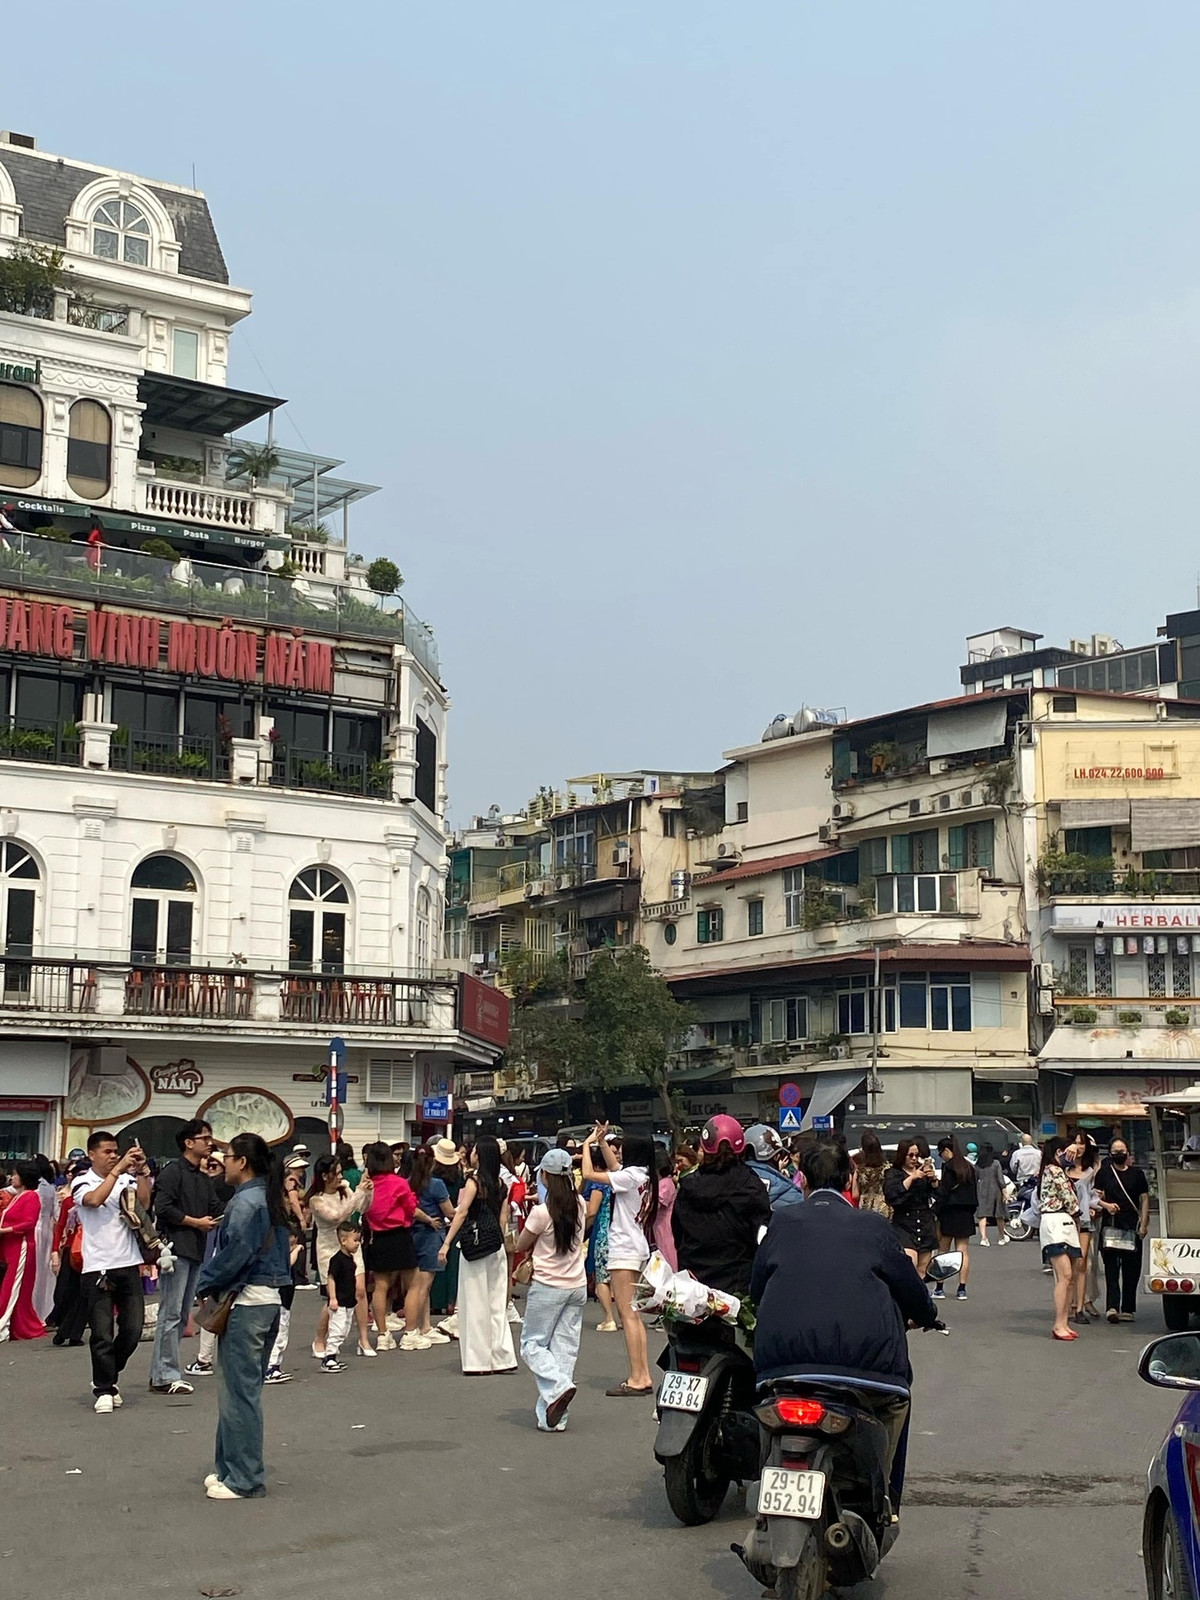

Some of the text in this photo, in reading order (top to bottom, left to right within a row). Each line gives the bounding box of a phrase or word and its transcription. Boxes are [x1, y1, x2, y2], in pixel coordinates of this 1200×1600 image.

[18, 501, 65, 513] Cocktails
[130, 522, 266, 547] Pizza Pasta Burger
[87, 610, 160, 670] VINH
[167, 616, 257, 682] MUÔN
[265, 627, 332, 693] NĂM
[668, 1374, 701, 1392] 29-X7
[770, 1472, 814, 1493] 29-C1
[763, 1492, 816, 1514] 952.94
